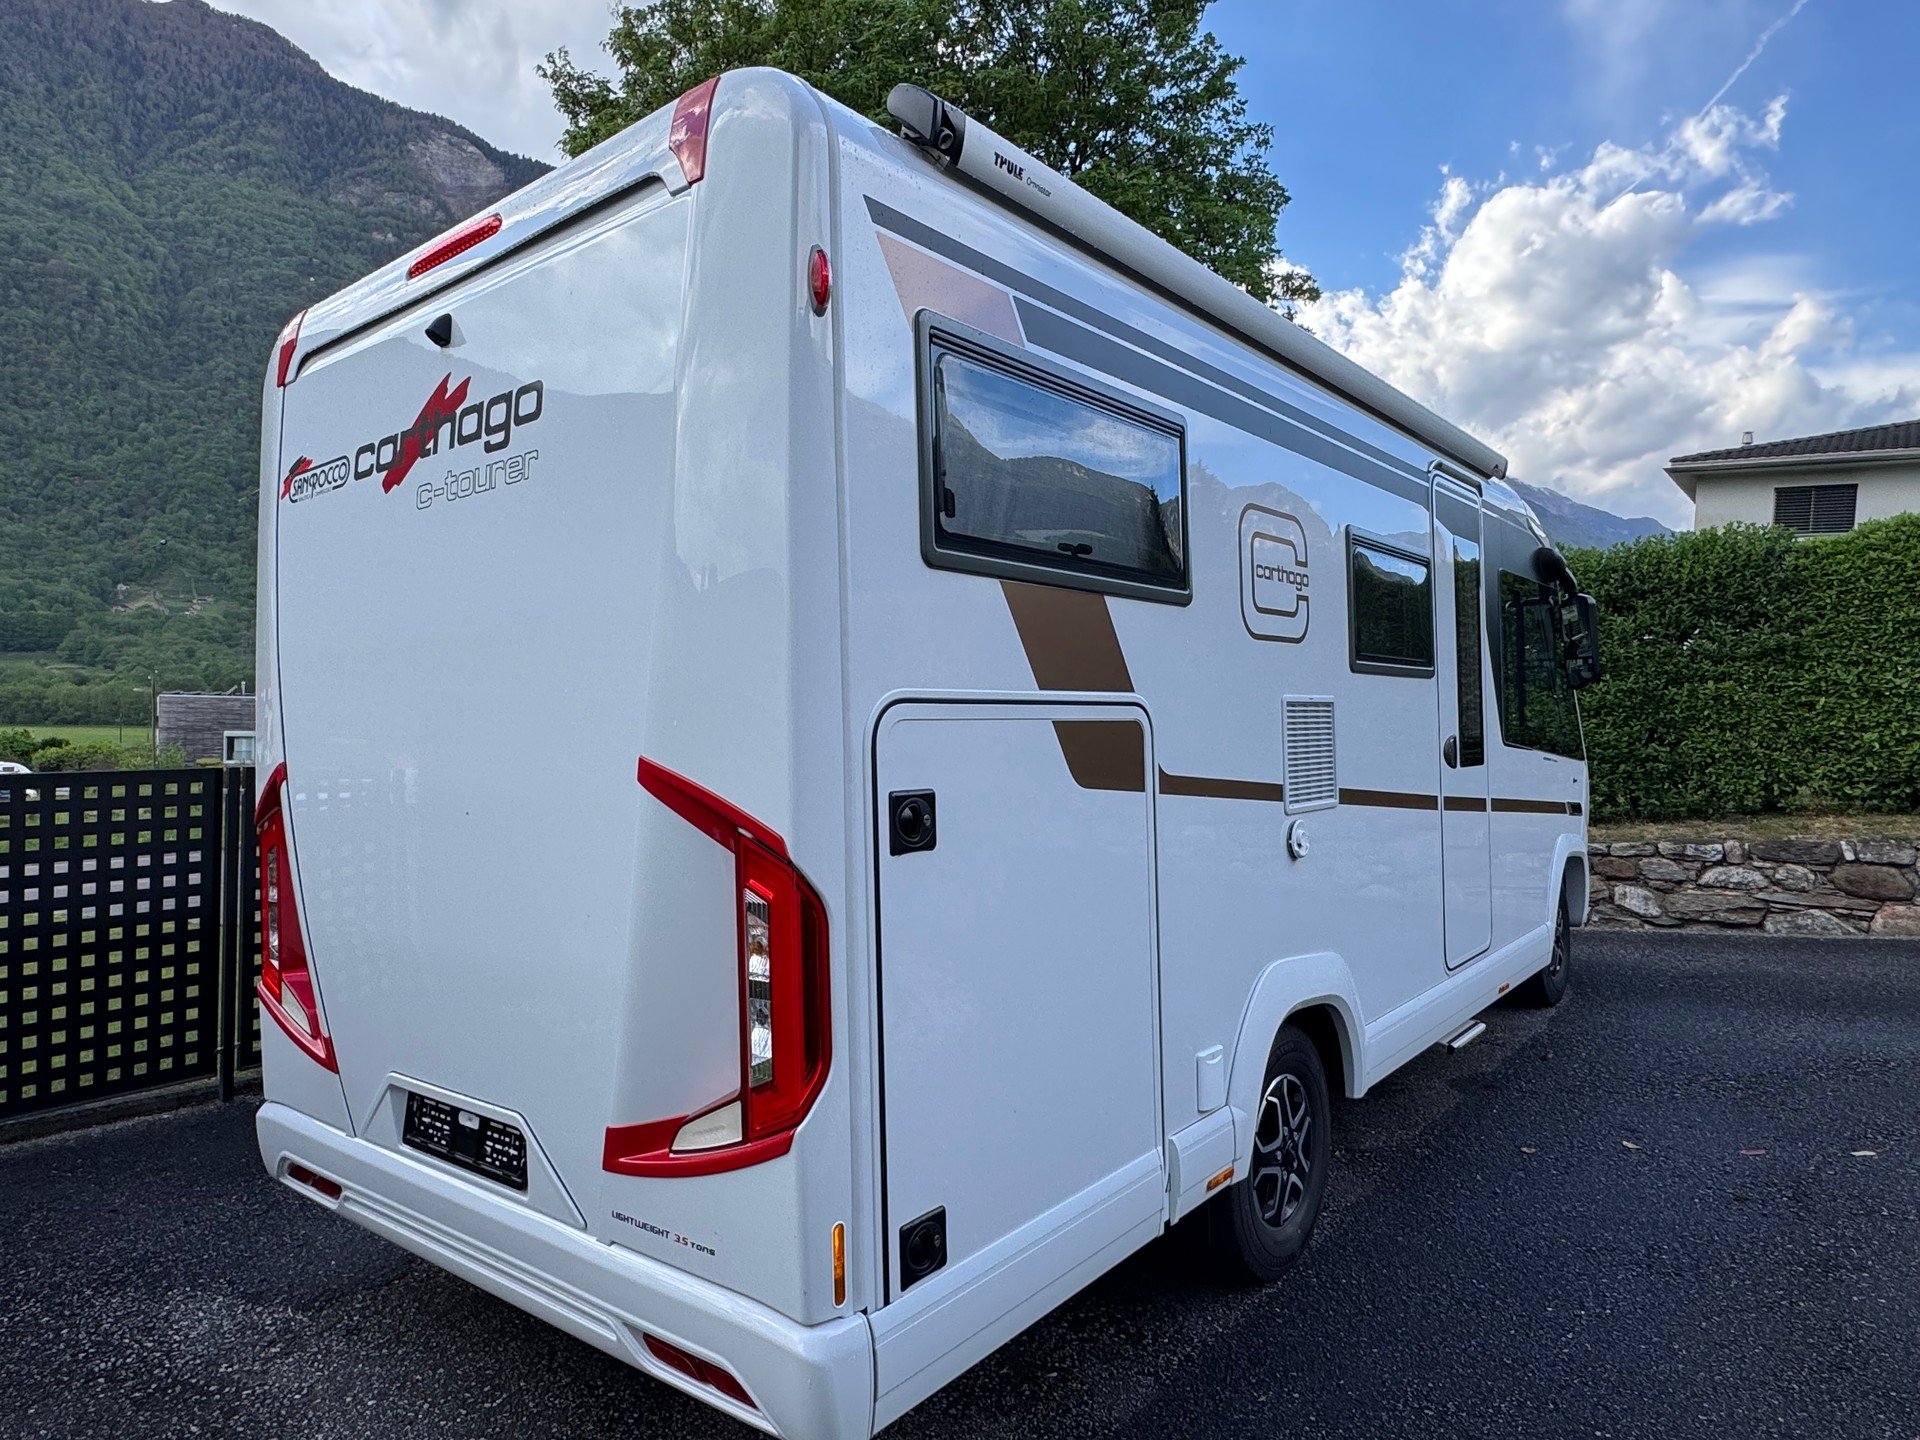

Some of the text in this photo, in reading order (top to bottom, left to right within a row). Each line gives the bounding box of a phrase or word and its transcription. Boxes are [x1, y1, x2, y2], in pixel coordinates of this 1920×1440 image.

[994, 151, 1024, 181] THULE
[354, 380, 543, 481] carthago
[416, 449, 539, 510] c-tourer
[1255, 563, 1309, 592] carthago
[611, 1210, 670, 1239] LIGHTWEIGHT
